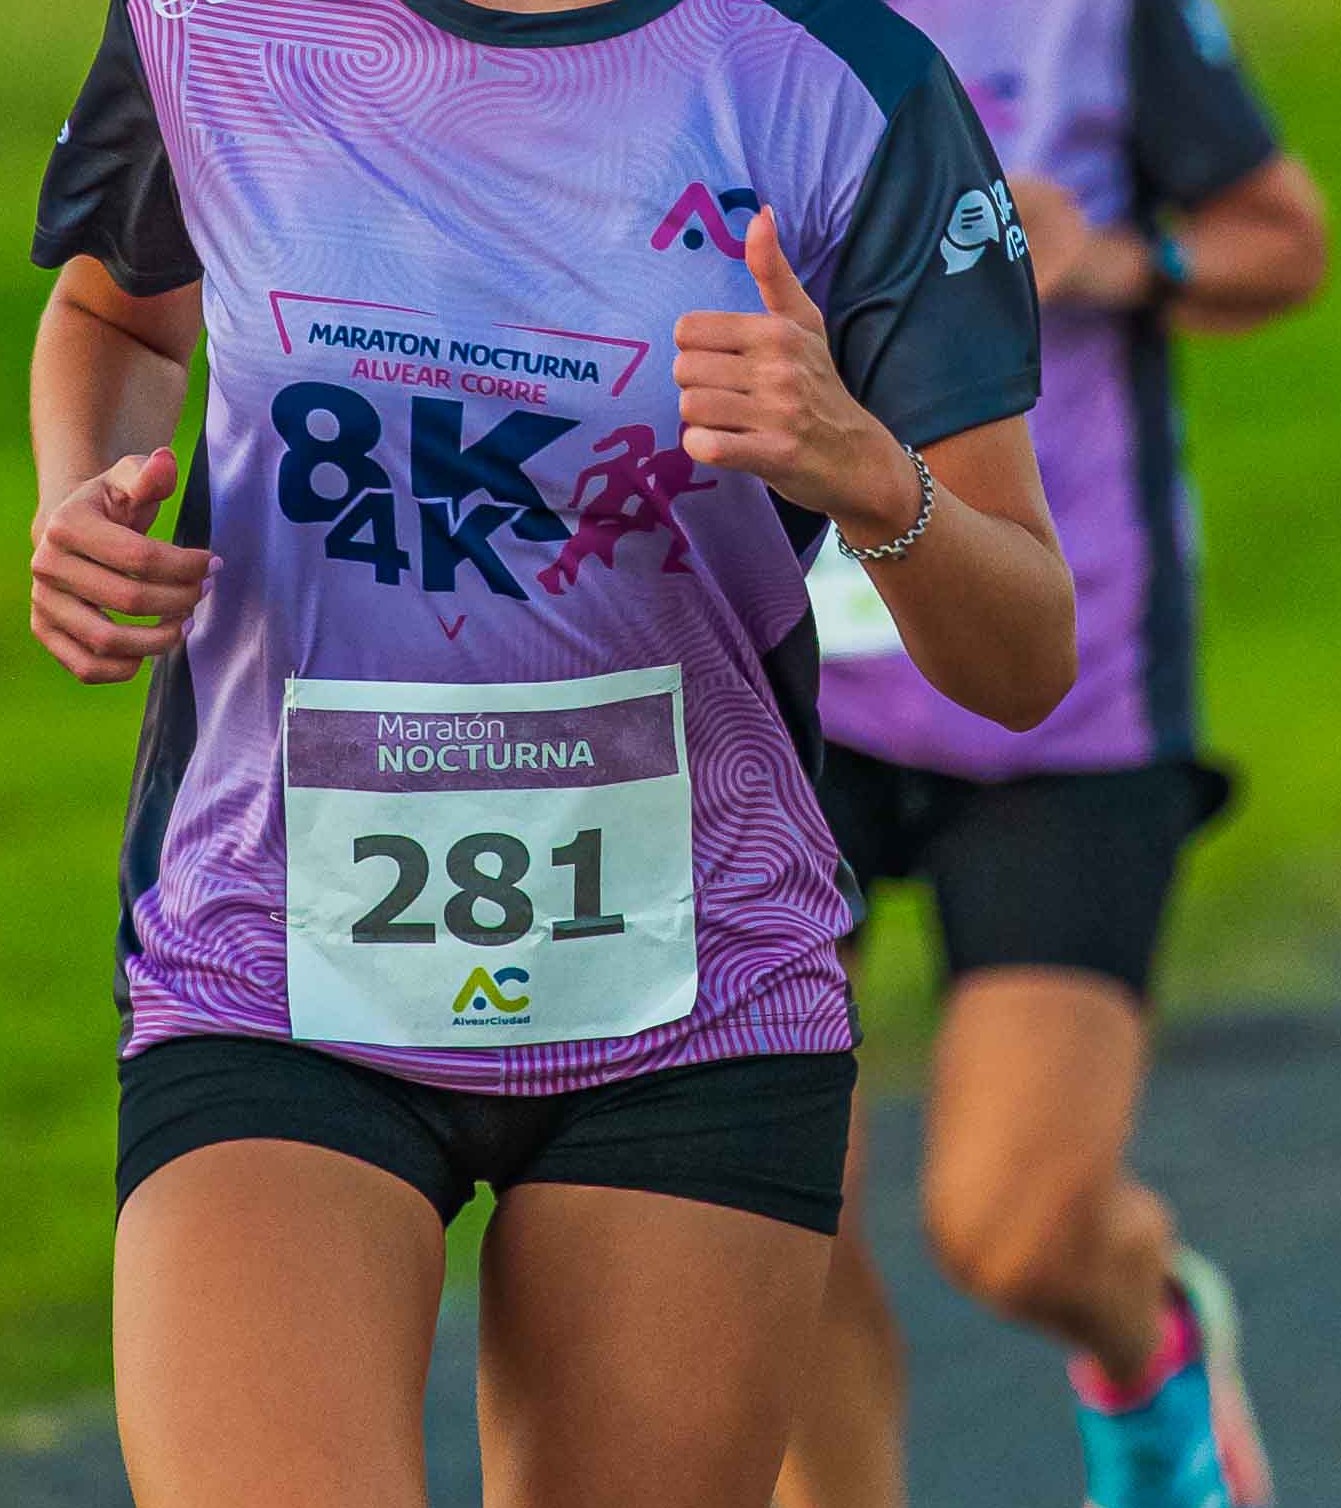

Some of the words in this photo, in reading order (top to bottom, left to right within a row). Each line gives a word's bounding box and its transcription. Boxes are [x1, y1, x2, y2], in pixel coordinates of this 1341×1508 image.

[309, 322, 440, 359] MARATON
[449, 341, 599, 384] NOCTURNA
[352, 358, 452, 389] ALVEAR
[461, 372, 548, 404] CORRE
[325, 493, 530, 601] 4K
[378, 714, 505, 740] Maratón
[378, 741, 595, 773] NOCTURNA
[352, 828, 624, 946] 281
